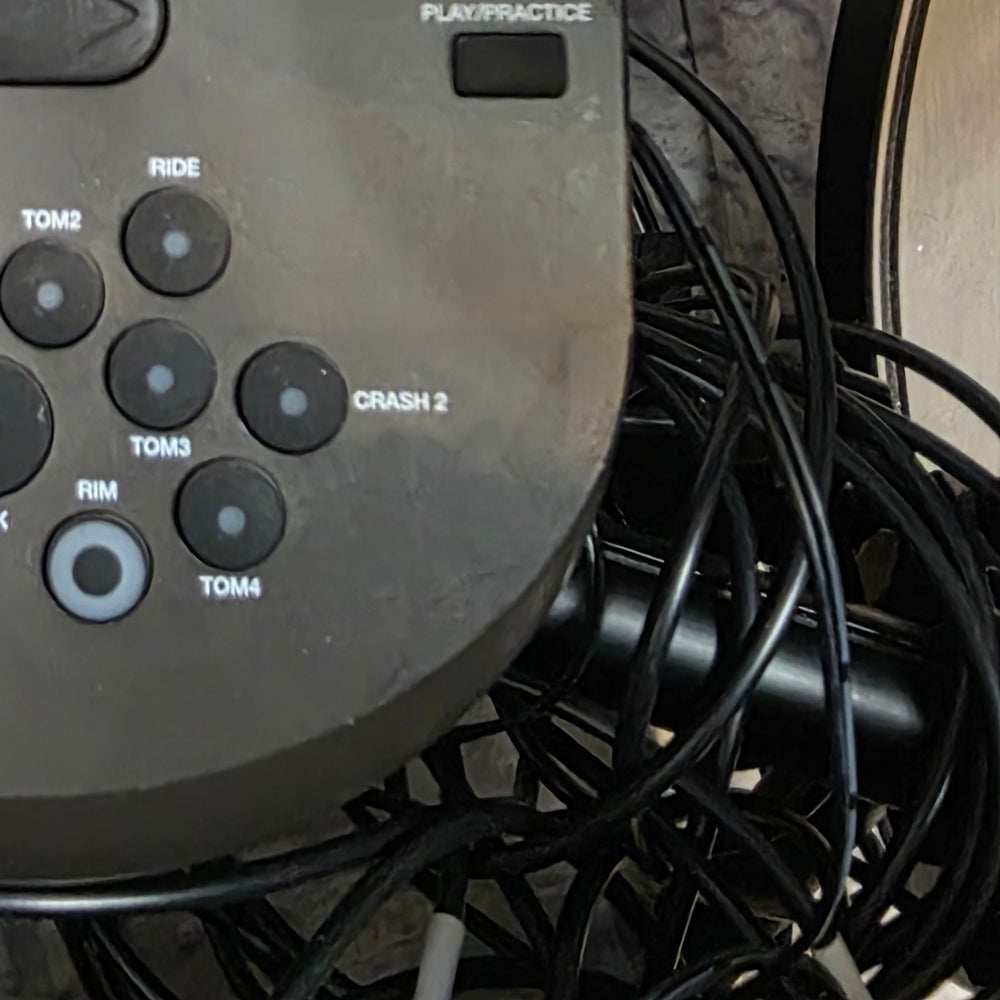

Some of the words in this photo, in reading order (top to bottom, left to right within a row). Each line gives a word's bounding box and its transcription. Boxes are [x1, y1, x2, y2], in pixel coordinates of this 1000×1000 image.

[420, 3, 593, 23] PLAY/PRACTICE
[149, 157, 201, 178] RIDE
[22, 209, 82, 231] TOM2
[353, 391, 430, 412] CRASH
[433, 392, 449, 412] 2
[130, 437, 191, 458] TOM3
[76, 480, 118, 501] RIM
[199, 576, 262, 598] TOM4
